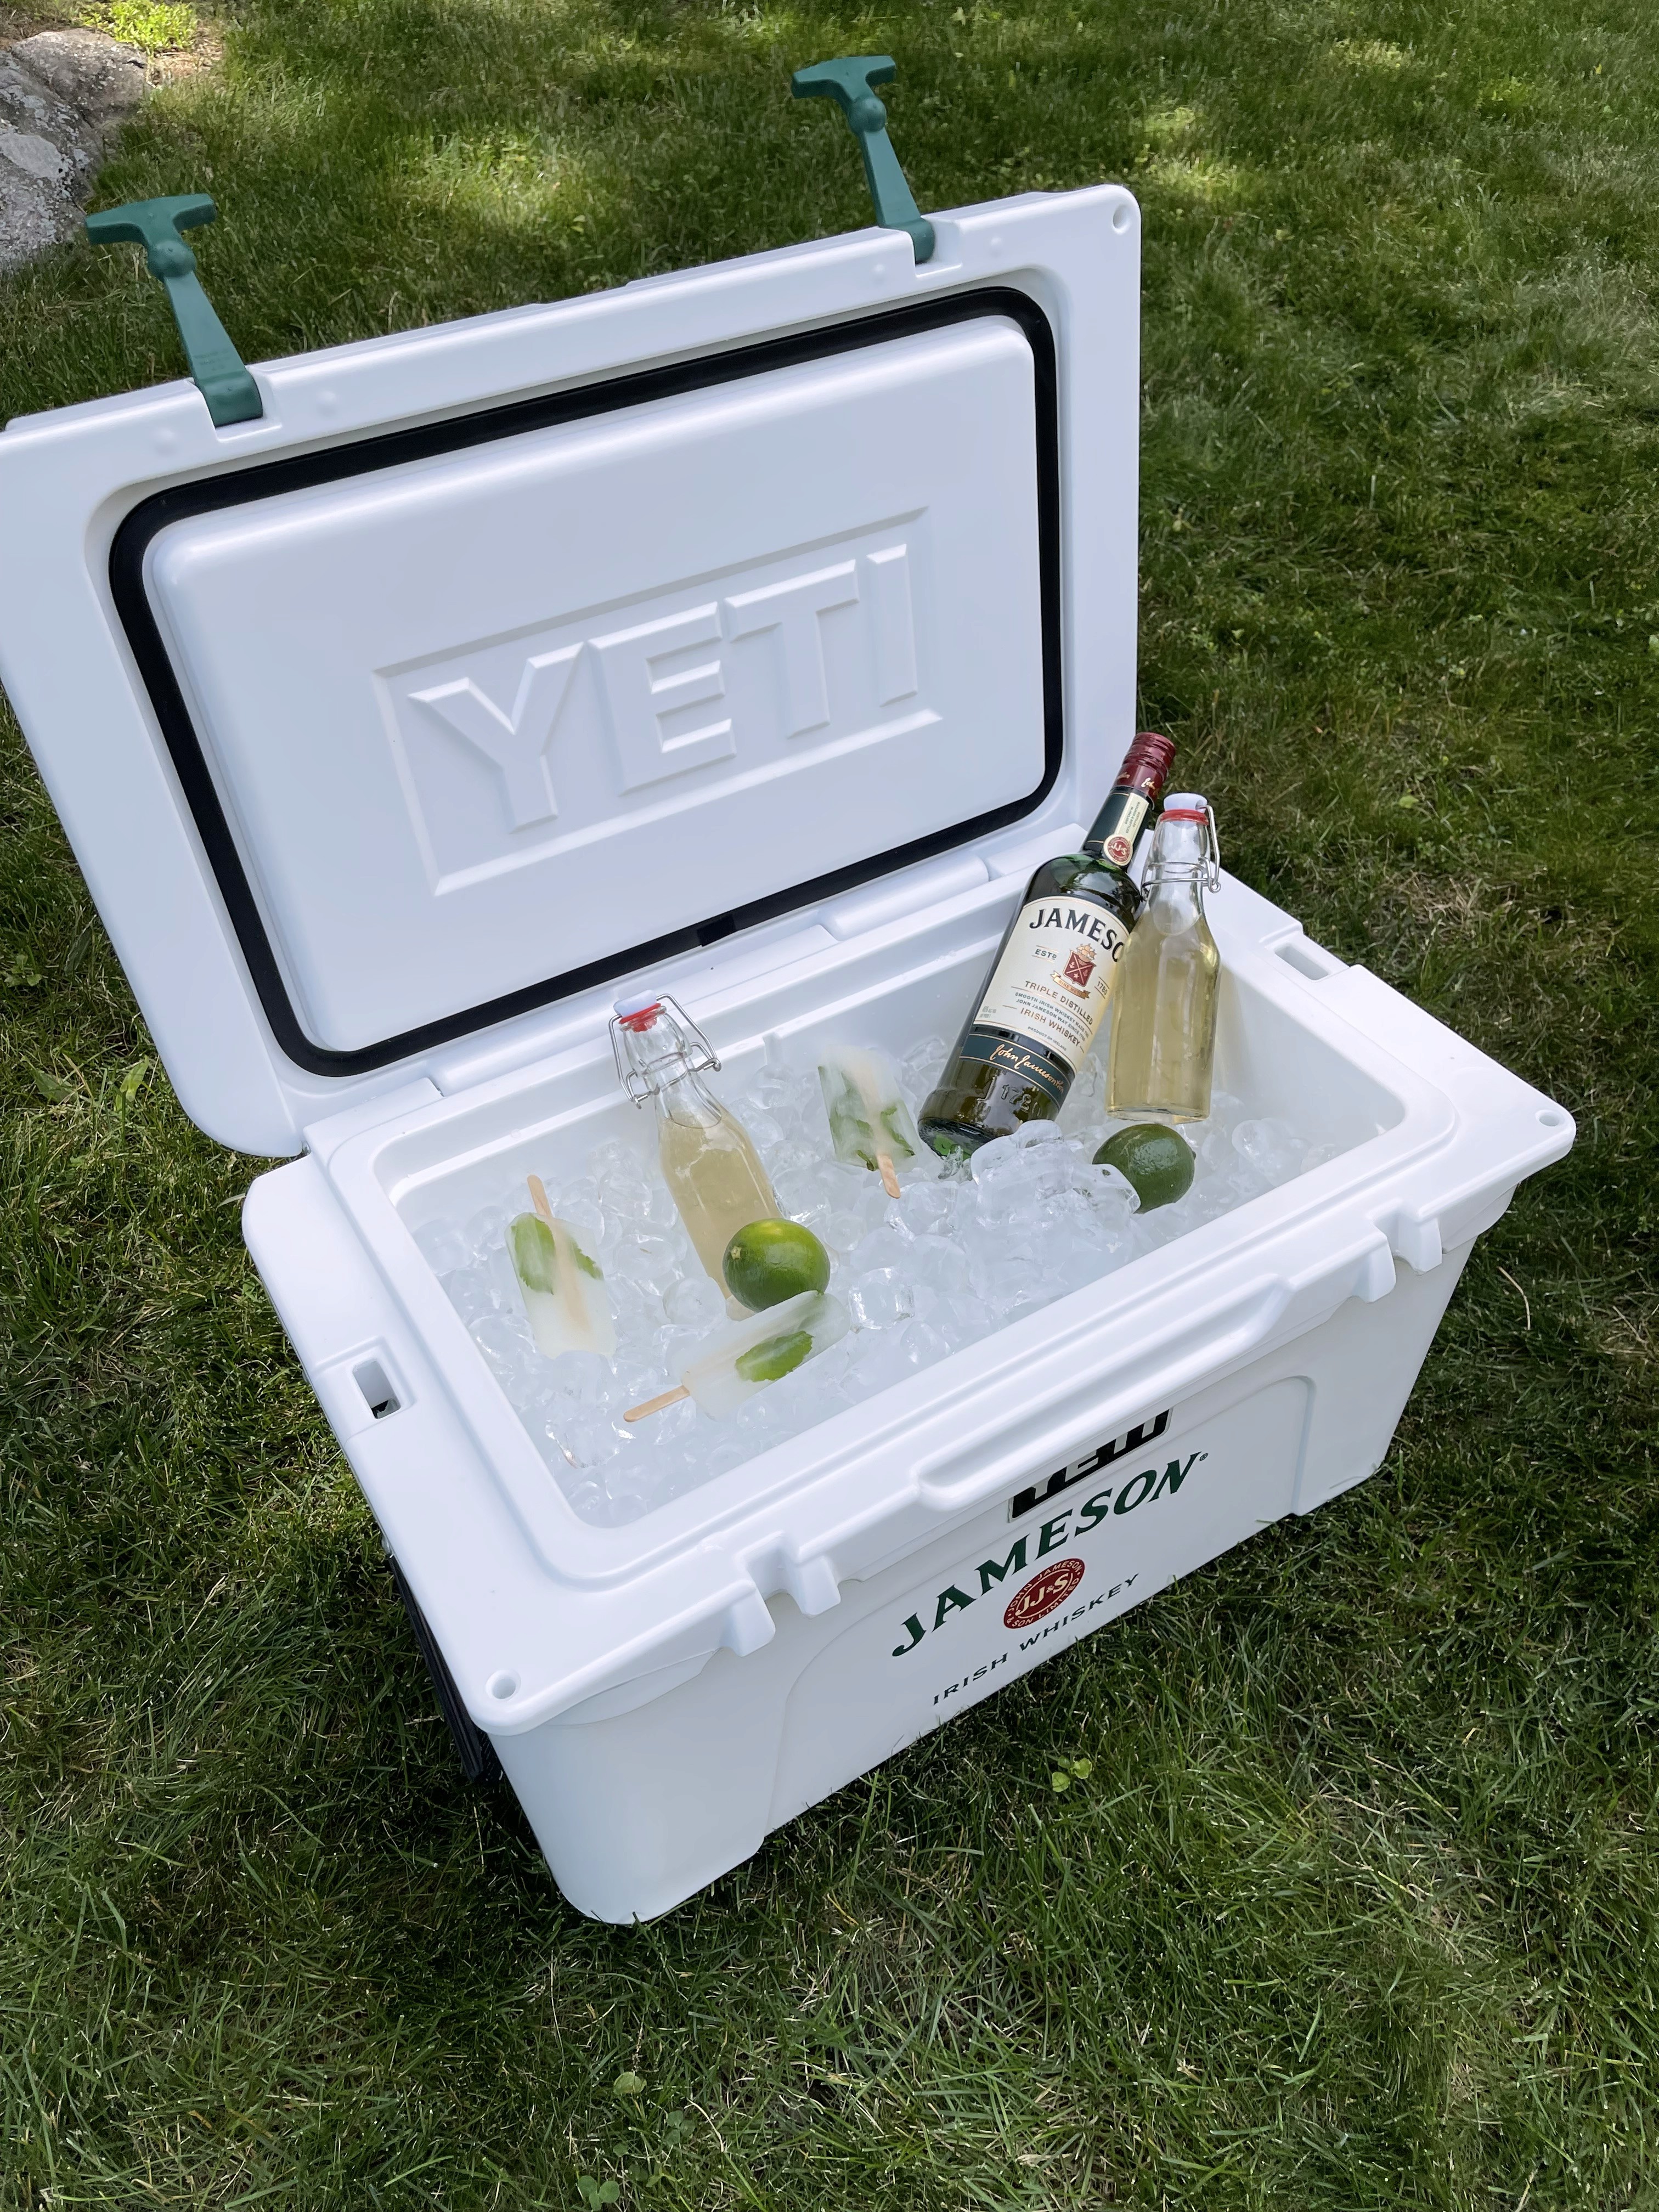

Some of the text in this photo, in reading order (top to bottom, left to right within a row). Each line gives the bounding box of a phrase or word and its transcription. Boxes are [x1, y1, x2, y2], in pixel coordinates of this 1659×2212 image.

[408, 543, 917, 833] YETI
[1029, 908, 1124, 962] JAMESO
[1015, 992, 1038, 1003] SMOOTH
[1039, 1000, 1053, 1010] IRISH
[1054, 1008, 1075, 1023] WHISKEY
[1075, 1022, 1085, 1032] MADE
[1016, 998, 1031, 1007] JOHN
[1032, 1005, 1057, 1019] JAMESON
[1058, 1015, 1068, 1026] WAY
[1068, 1023, 1079, 1035] SINCE
[1025, 980, 1093, 1025] TRIPLE DISTILLED
[1020, 1008, 1047, 1024] IRISH
[1048, 1019, 1080, 1047] WHISKEY
[1028, 1026, 1047, 1038] PRODUCT
[990, 1043, 1019, 1062] John
[1007, 1560, 1082, 1612] JOHN JAMESON
[1012, 1617, 1034, 1627] SON
[1039, 1578, 1079, 1618] LIMITED
[1014, 1572, 1069, 1616] JJ&S
[933, 1572, 1139, 1706] IRISH WHISKEY
